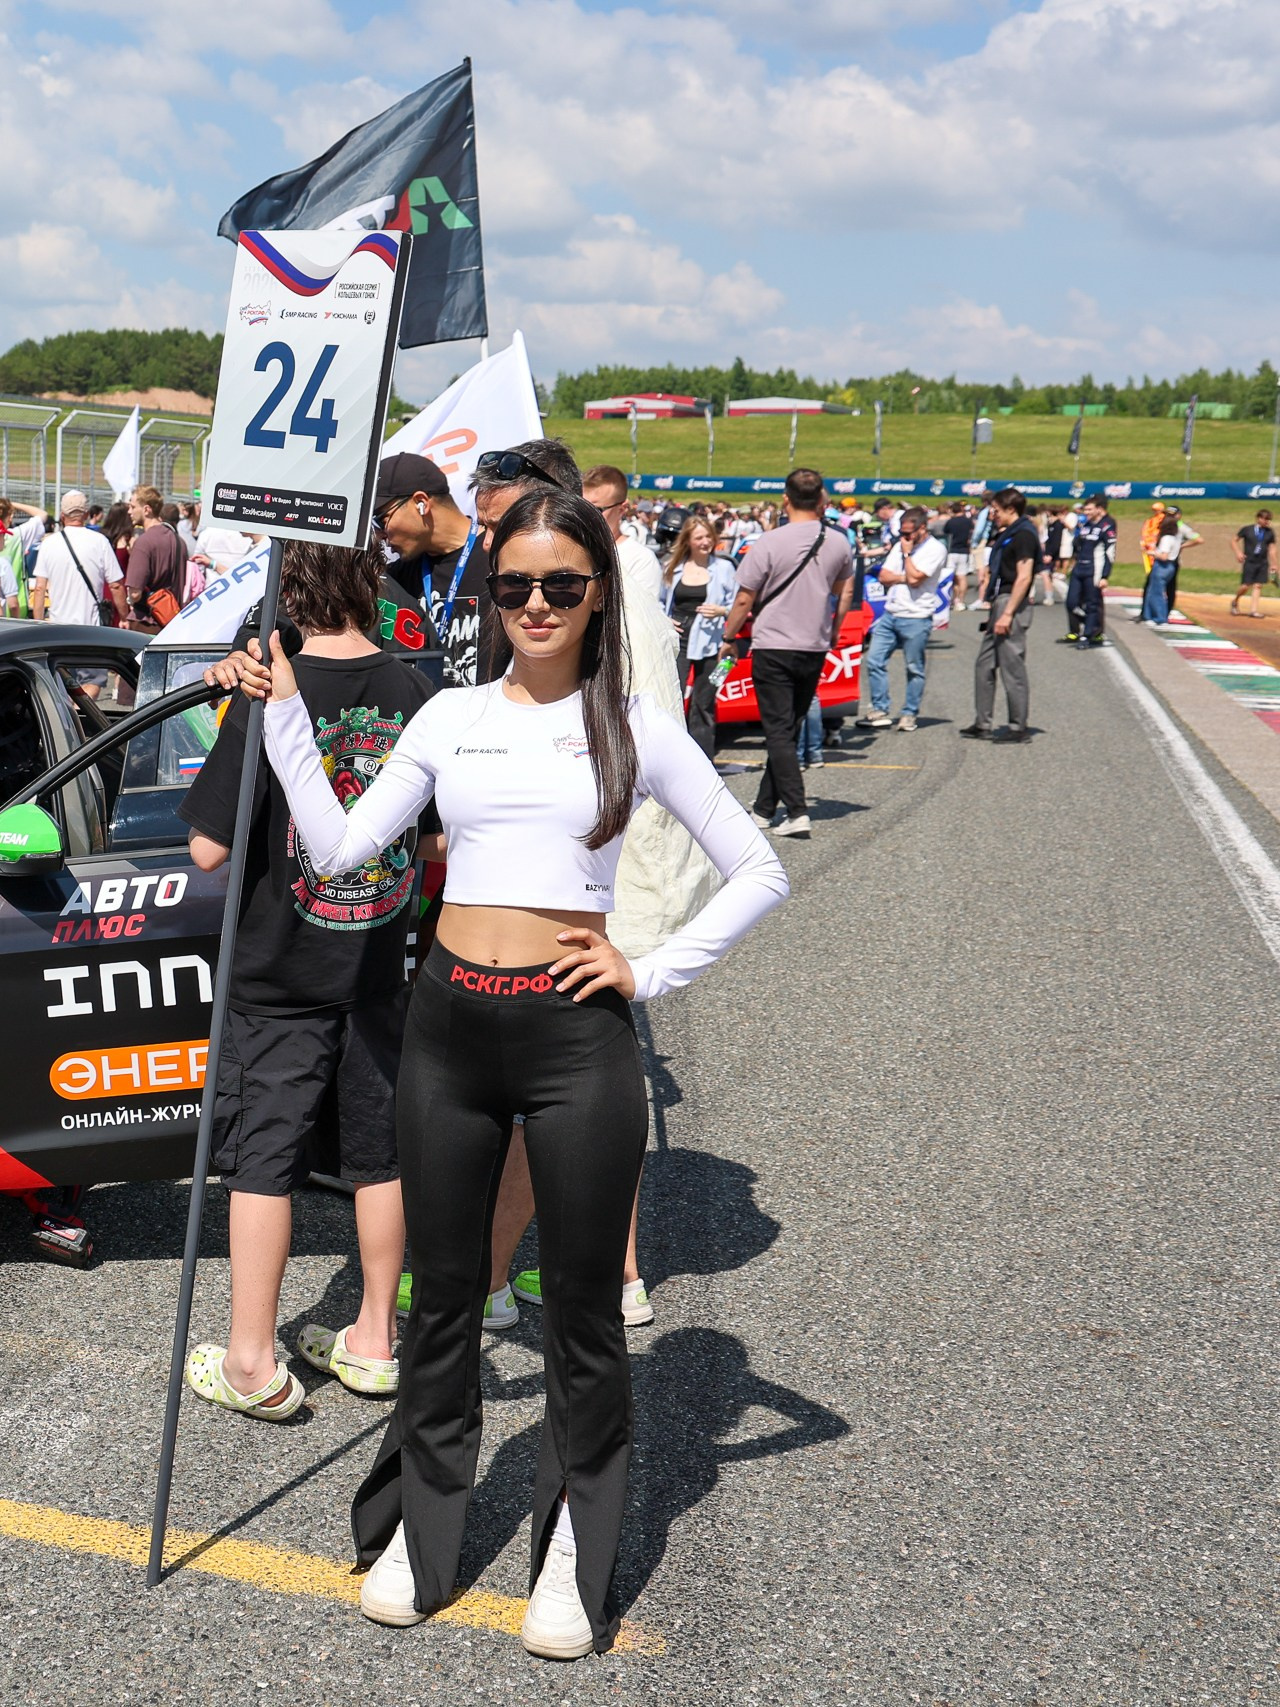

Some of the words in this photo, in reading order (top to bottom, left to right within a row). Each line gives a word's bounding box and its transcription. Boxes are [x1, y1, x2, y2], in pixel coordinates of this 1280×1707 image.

[244, 341, 340, 453] 24
[328, 503, 344, 511] VOICE
[0, 832, 29, 846] TEAM
[59, 872, 188, 916] АВТО
[337, 885, 378, 899] DISEASE
[51, 913, 146, 944] ПЛЮС
[450, 965, 553, 995] РСКГ.РФ
